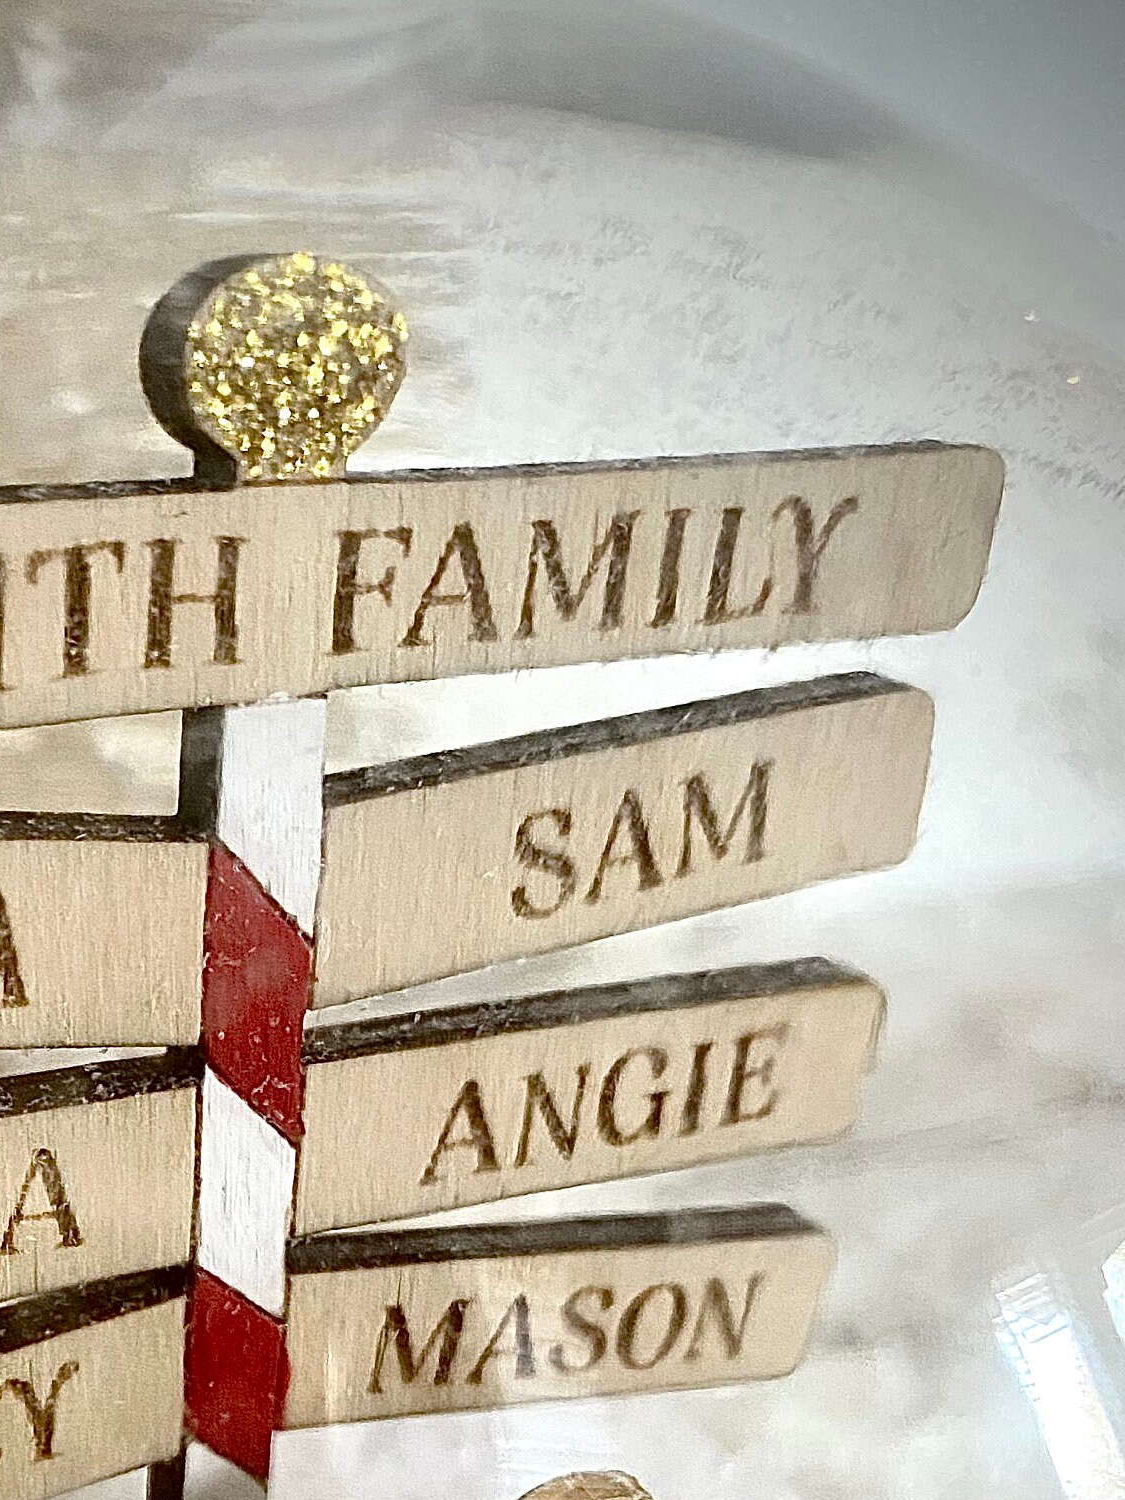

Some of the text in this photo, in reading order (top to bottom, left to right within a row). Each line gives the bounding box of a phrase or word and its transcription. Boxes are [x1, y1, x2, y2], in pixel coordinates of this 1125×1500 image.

[328, 494, 860, 657] FAMILY
[509, 758, 775, 920] SAM
[419, 1021, 792, 1187] ANGIE
[365, 1268, 765, 1395] MASON
